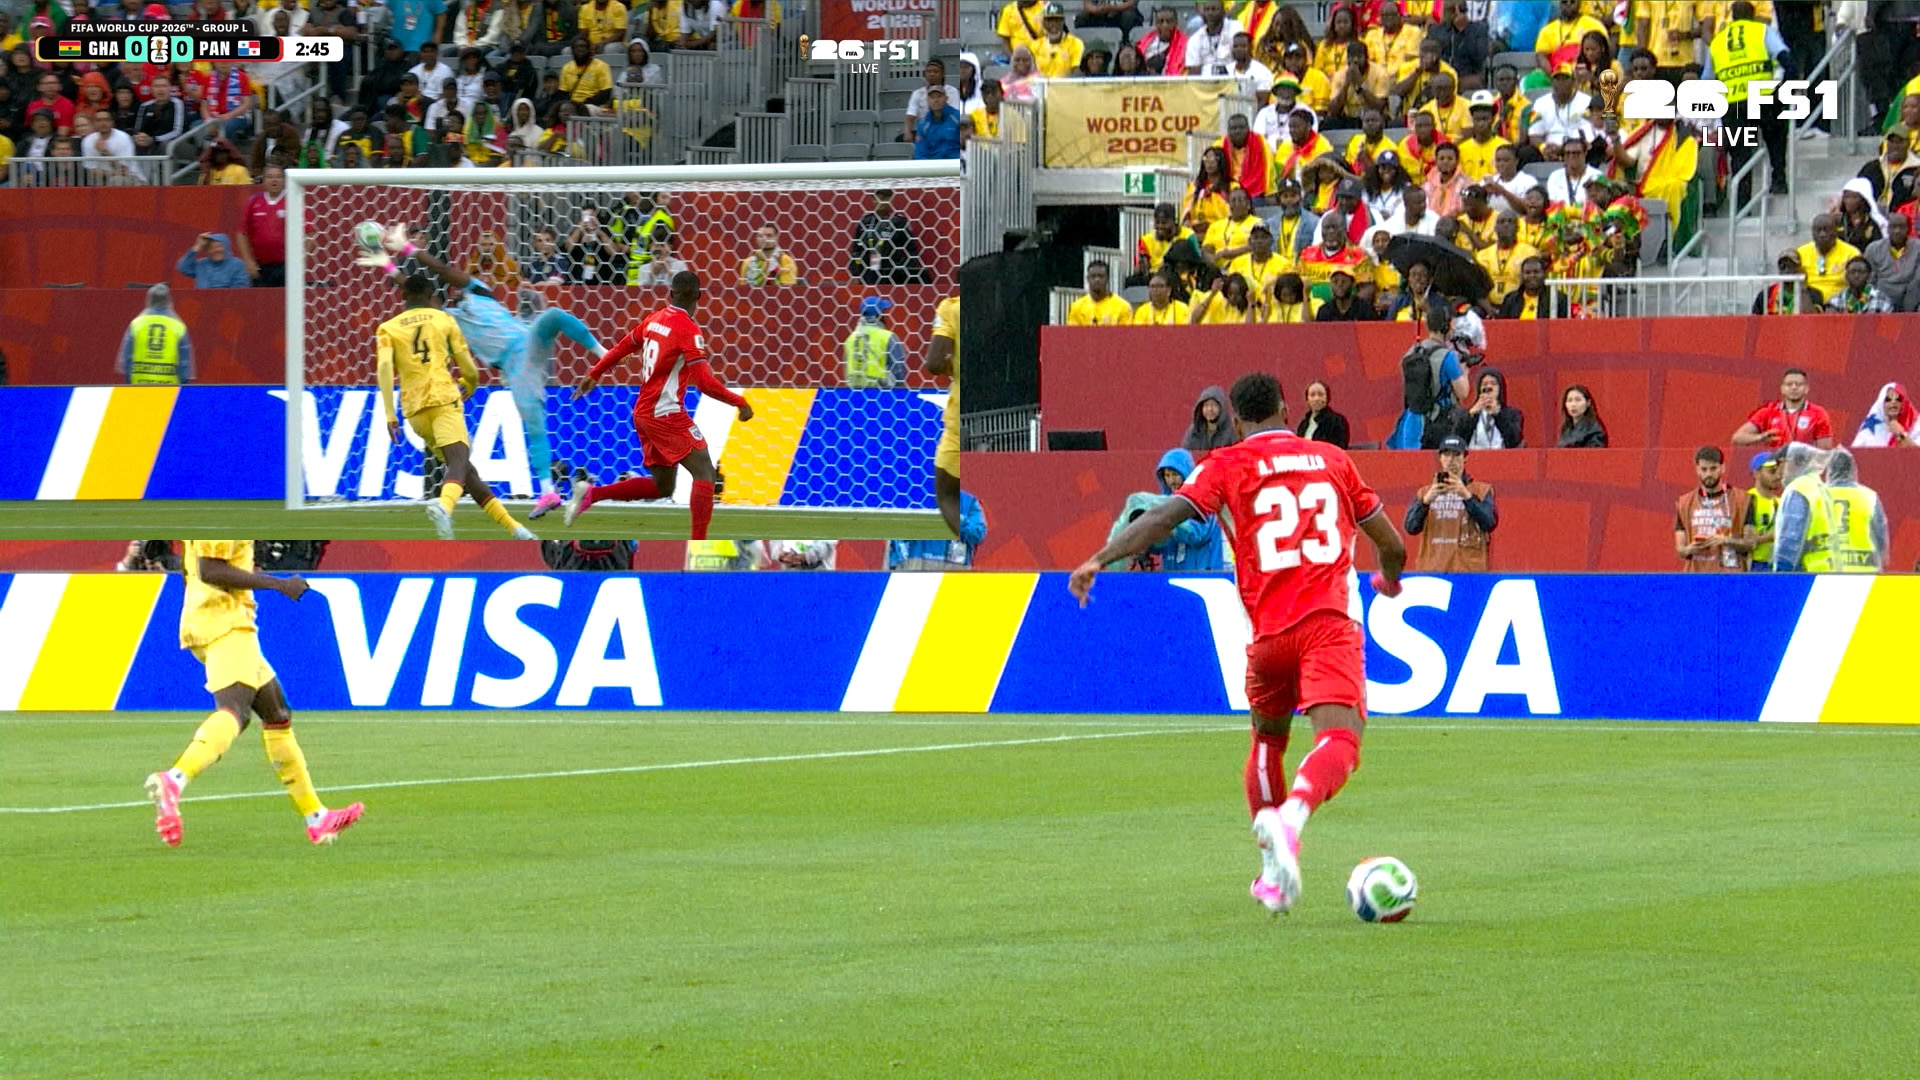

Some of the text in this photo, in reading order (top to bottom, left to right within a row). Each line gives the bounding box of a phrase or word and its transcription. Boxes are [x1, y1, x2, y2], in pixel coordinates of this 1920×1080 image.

[1086, 115, 1200, 133] WORLD CUP
[1121, 96, 1165, 113] FIFA
[1107, 137, 1177, 153] 2026
[412, 324, 431, 364] 4
[1253, 481, 1343, 573] 23
[305, 575, 664, 708] VISA
[1168, 576, 1562, 715] VSA
